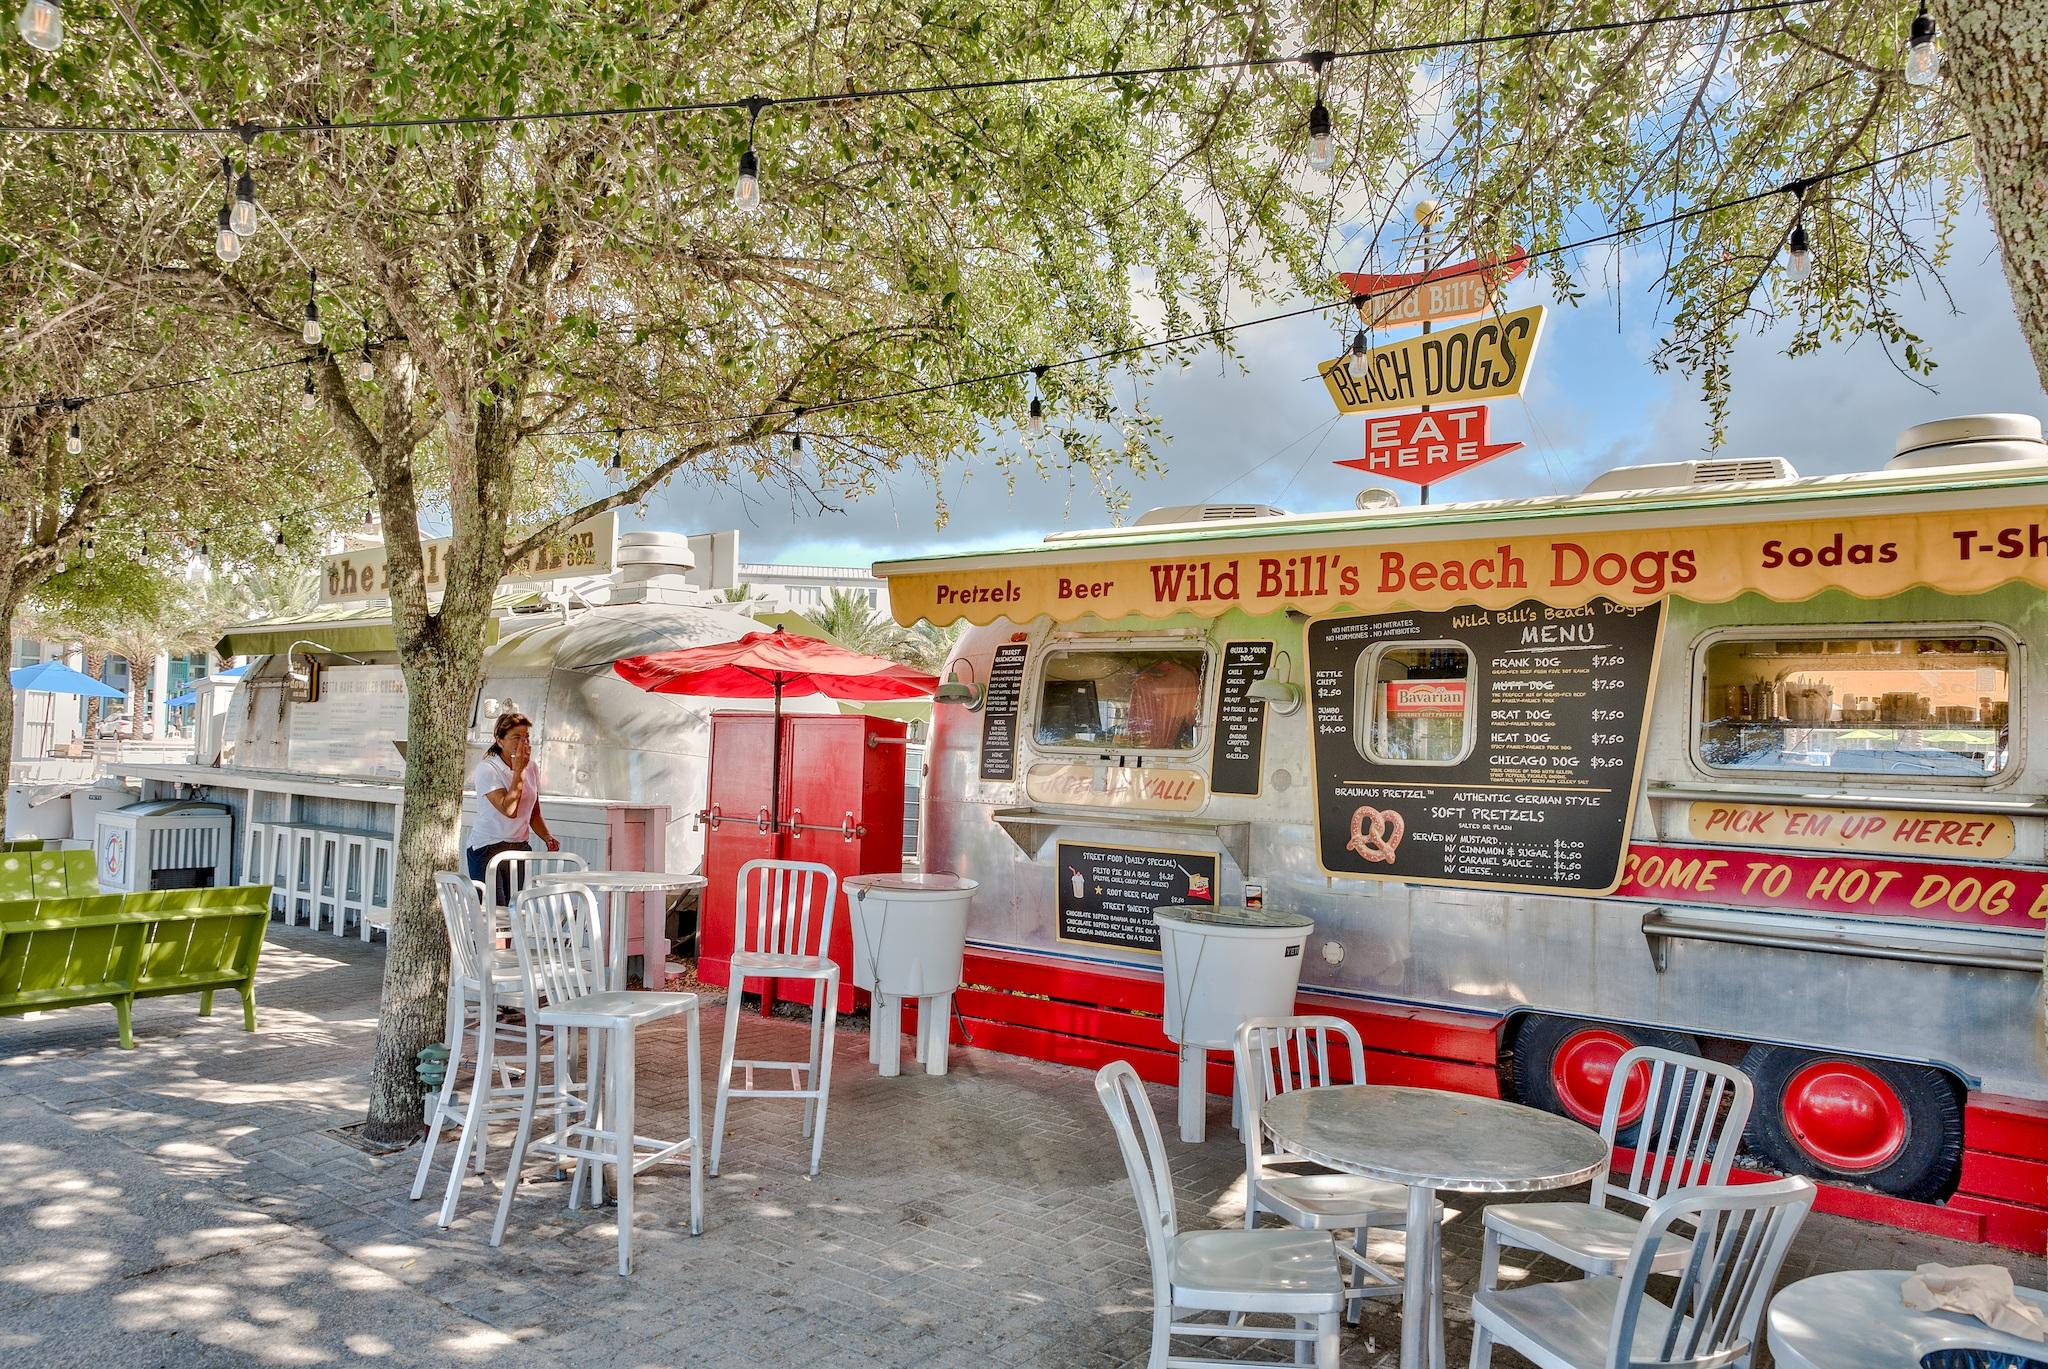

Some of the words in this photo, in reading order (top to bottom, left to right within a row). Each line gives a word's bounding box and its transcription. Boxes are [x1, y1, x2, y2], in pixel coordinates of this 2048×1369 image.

[1371, 287, 1420, 322] Wild
[1429, 280, 1486, 314] Bill's
[1333, 347, 1415, 406] BEACH
[1422, 316, 1530, 397] DOGS
[1371, 411, 1478, 449] EAT
[1369, 441, 1479, 469] HERE
[936, 580, 1021, 605] Pretzels
[1058, 577, 1114, 599] Beer
[1150, 560, 1239, 602] Wild
[1256, 554, 1360, 598] Bill's
[1377, 544, 1528, 593] Beach
[1549, 541, 1698, 595] Dogs
[1761, 532, 1898, 569] Sodas
[328, 558, 374, 596] the
[1452, 614, 1491, 629] Wild
[1497, 607, 1537, 625] Bill's
[1544, 605, 1595, 620] Beach
[1373, 622, 1382, 630] NO
[1383, 620, 1414, 629] NITRATES
[1335, 632, 1369, 641] HORMONES
[1383, 627, 1421, 636] ANTIBIOTICS
[1521, 622, 1594, 645] MENU
[1492, 657, 1530, 668] FRANK
[1535, 657, 1562, 667] DOG
[1592, 655, 1625, 668] $7.50
[1316, 670, 1343, 678] KETTLE
[1316, 678, 1337, 686] CHIPS
[1492, 680, 1526, 691] MUTT
[1529, 680, 1555, 690] DOG
[1592, 678, 1625, 692] $7.50
[1317, 688, 1342, 699] $2.50
[1399, 689, 1462, 704] Bavarian
[1318, 714, 1344, 722] PICKLE
[1491, 710, 1521, 720] BRAT
[1525, 710, 1552, 720] DOG
[1591, 709, 1625, 721] $7.50
[1320, 724, 1347, 735] $4.00
[1491, 733, 1519, 743] HEAT
[1524, 733, 1551, 743] DOG
[1591, 733, 1625, 745] $7.50
[1489, 756, 1547, 767] CHICAGO
[1552, 756, 1580, 767] DOG
[1591, 756, 1624, 769] $9.50
[1335, 788, 1379, 797] BRAUHAUS
[1453, 793, 1511, 803] AUTHENTIC
[1515, 795, 1562, 805] GERMAN
[1565, 796, 1600, 806] STYLE
[1431, 807, 1466, 818] SOFT
[1472, 808, 1545, 822] PRETZELS
[1706, 808, 1774, 834] PICK
[1784, 808, 1833, 837] 'EM
[1840, 814, 1887, 840] UP
[1892, 817, 1996, 847] HERE!
[1412, 832, 1443, 842] SERVED
[1445, 834, 1457, 843] W/
[1554, 839, 1584, 849] $6.00
[1444, 844, 1457, 853] W/
[1459, 845, 1504, 856] CINNAMON
[1507, 847, 1515, 856] &
[1554, 849, 1582, 860] $6.50
[1083, 852, 1107, 861] STREET
[1107, 854, 1123, 863] FOOD
[1125, 856, 1146, 866] (DAILY
[1147, 857, 1177, 869] SPECIAL)
[1444, 854, 1457, 863] W/
[1458, 856, 1500, 866] CARAMEL
[1502, 858, 1533, 868] SAUCE
[1554, 860, 1582, 871] $6.50
[1093, 867, 1111, 875] FRITO
[1137, 871, 1151, 879] BAG
[1444, 865, 1457, 874] W/
[1553, 870, 1581, 882] $7.50
[1621, 853, 1729, 891] COME
[1740, 861, 1794, 898] TO
[1806, 866, 1902, 905] HOT
[1910, 875, 2016, 916] DOG
[1107, 888, 1122, 897] ROOT
[1124, 890, 1140, 899] BEER
[1141, 891, 1160, 901] FLOAT
[1102, 902, 1125, 911] STREET
[1127, 904, 1150, 914] SWEETS
[1066, 910, 1091, 919] CHOCOLATE
[1093, 912, 1109, 920] DIPPED
[1110, 914, 1128, 923] BANANA
[1093, 921, 1110, 929] DIPPED
[1122, 924, 1134, 932] LIME
[1077, 927, 1094, 935] CREAM
[1095, 929, 1125, 939] INDULGENCE
[1127, 932, 1133, 940] ON
[1139, 934, 1154, 943] STICK
